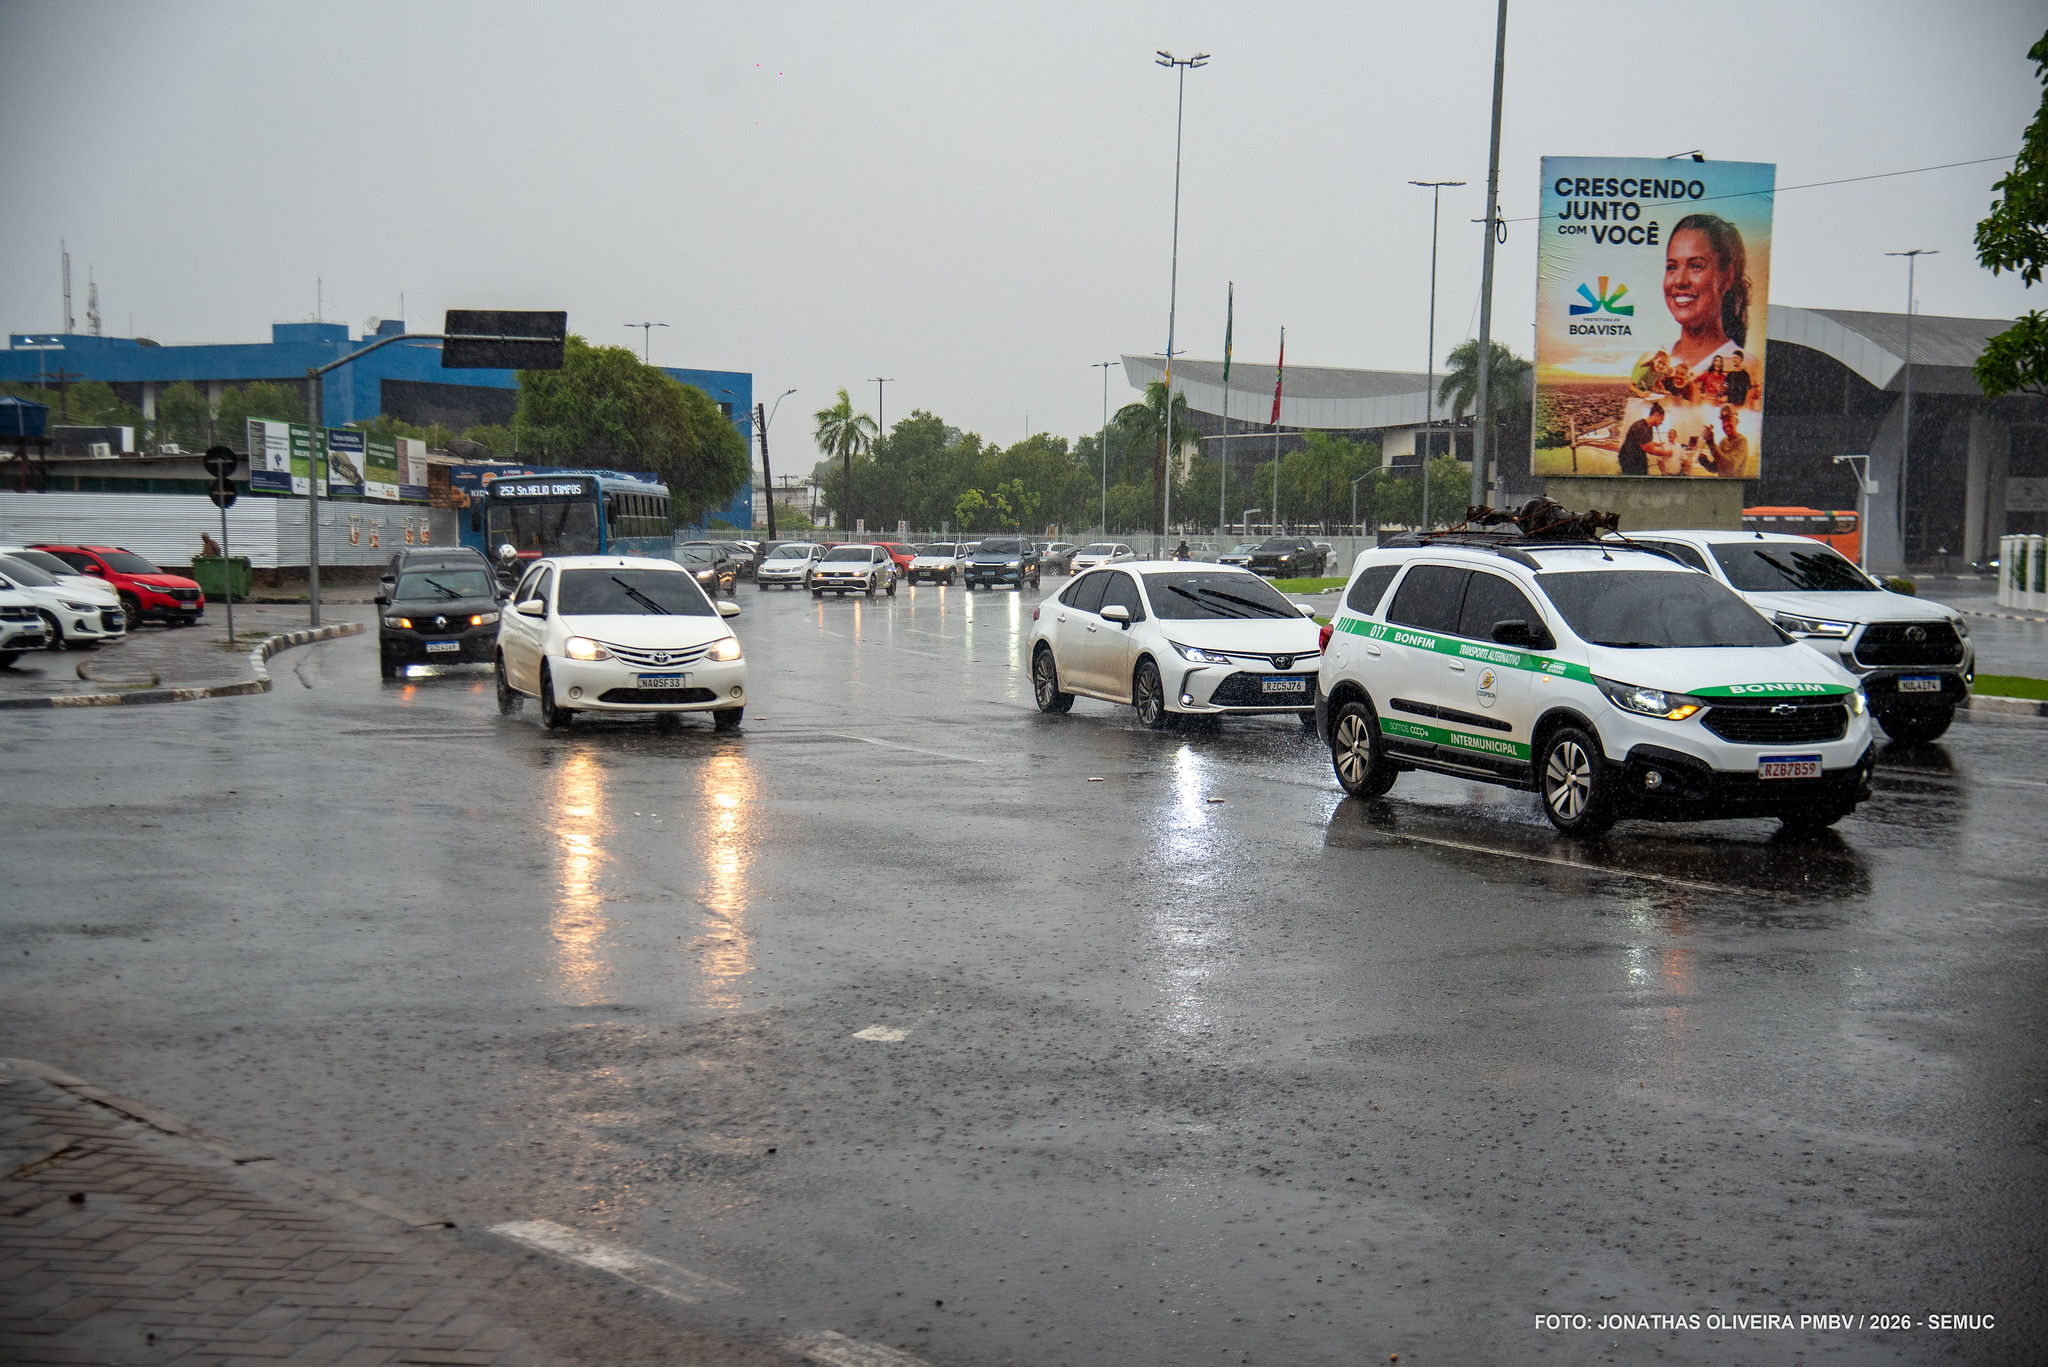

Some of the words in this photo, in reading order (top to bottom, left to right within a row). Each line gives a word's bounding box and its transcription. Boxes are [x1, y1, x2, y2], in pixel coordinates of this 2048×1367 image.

[1554, 177, 1705, 200] CRESCENDO
[1558, 200, 1641, 221] JUNTO
[1558, 225, 1587, 235] COM
[1590, 221, 1660, 245] VOCÊ
[500, 486, 514, 497] 252
[552, 484, 582, 495] CAMPOS
[1370, 625, 1387, 639] 017
[1394, 632, 1436, 649] BONFIM
[1459, 644, 1489, 659] TRANSPORTE
[1487, 649, 1521, 666] ALTERNATIVO
[642, 679, 680, 688] NAQ5F33
[1266, 682, 1302, 691] RZC5J76
[1729, 683, 1826, 694] BONFIM
[1389, 721, 1409, 733] somos
[1451, 733, 1518, 755] INTERMUNICIPAL
[1765, 763, 1816, 776] RZB7B59
